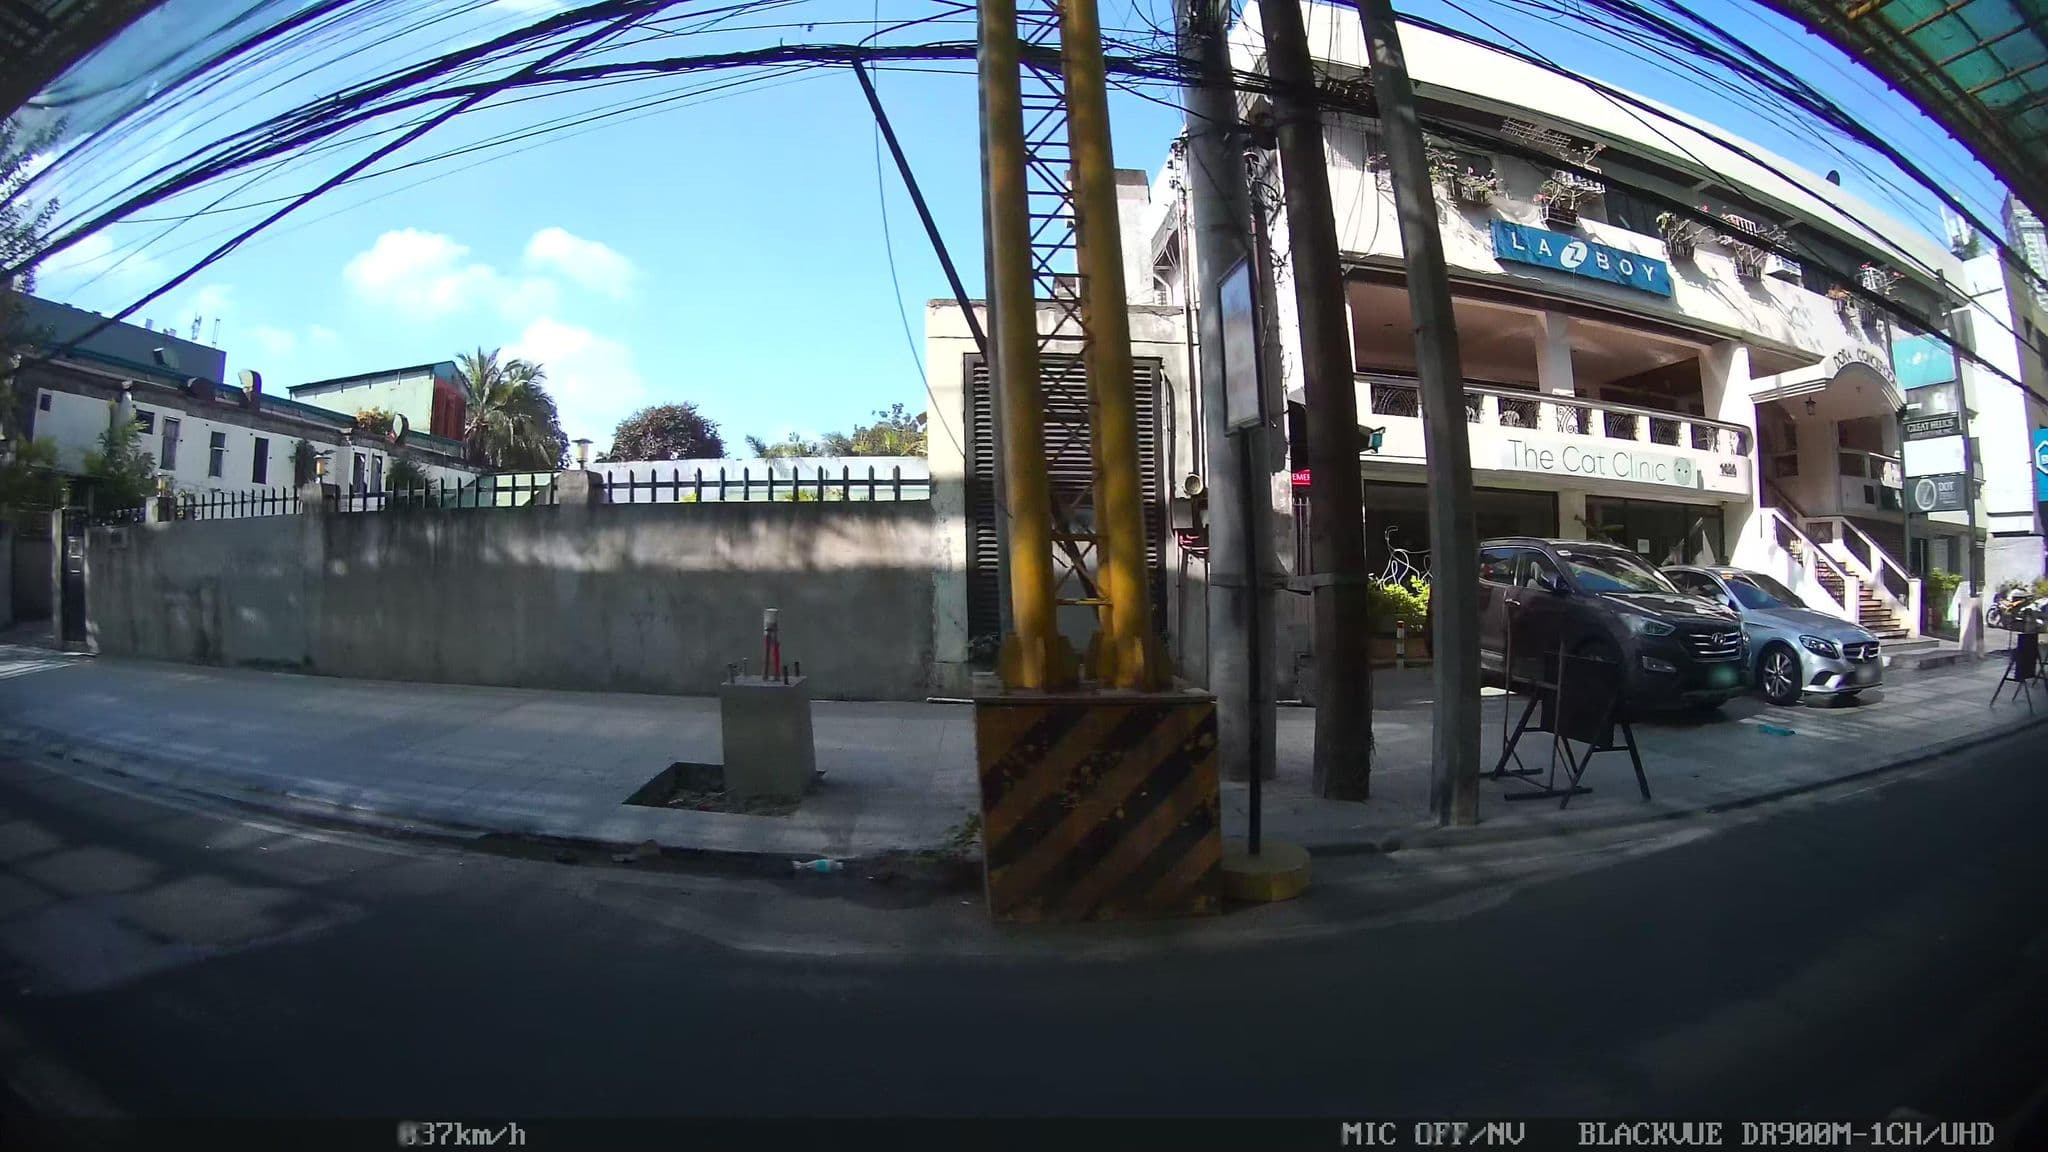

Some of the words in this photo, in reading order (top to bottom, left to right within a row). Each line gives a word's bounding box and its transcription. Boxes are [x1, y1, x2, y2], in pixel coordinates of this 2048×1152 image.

[1508, 439, 1554, 471] The
[1562, 445, 1606, 476] Cat
[1612, 450, 1667, 482] Clinic
